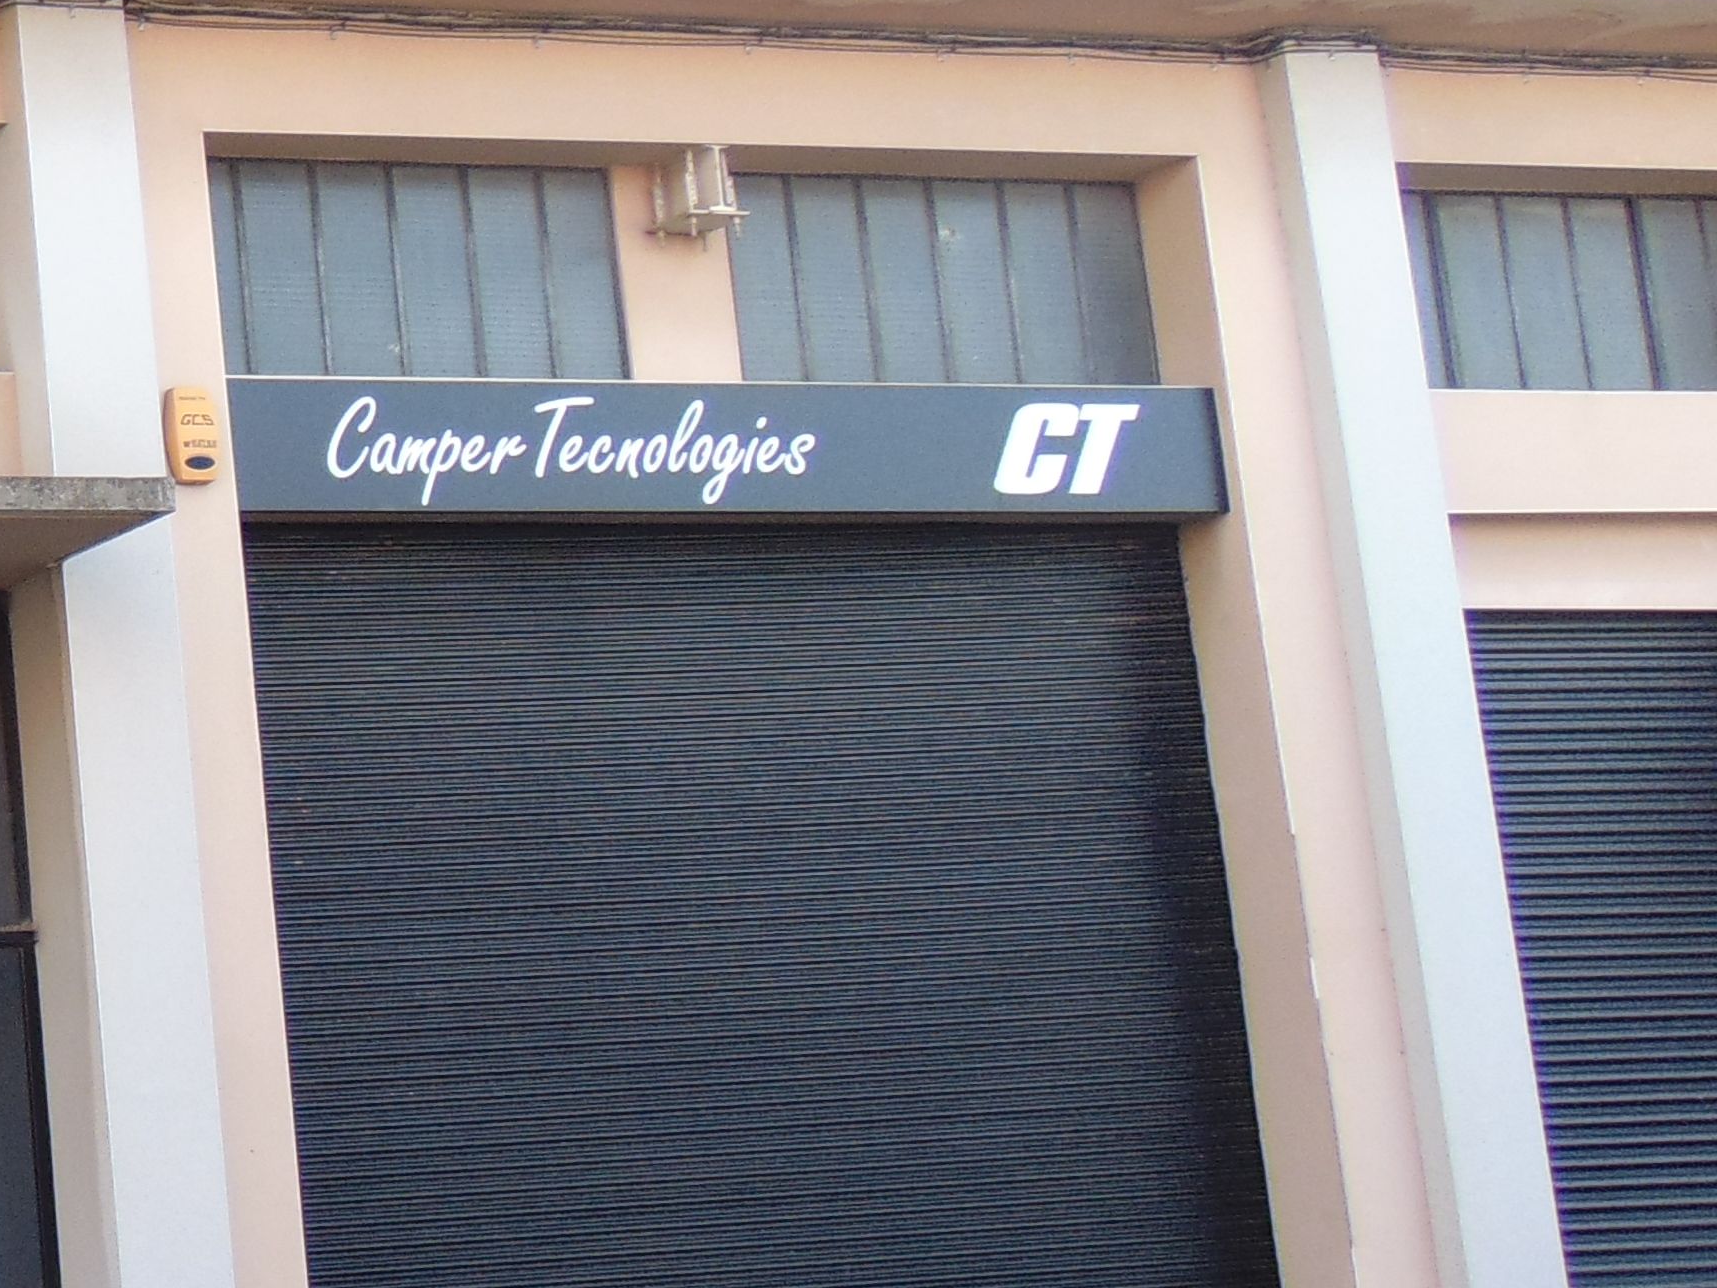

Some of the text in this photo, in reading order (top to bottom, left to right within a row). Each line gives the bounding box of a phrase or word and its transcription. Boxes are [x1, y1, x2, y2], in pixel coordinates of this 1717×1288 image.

[180, 413, 216, 426] GCS
[326, 396, 817, 506] Camper Tecnologies
[993, 402, 1142, 495] CT
